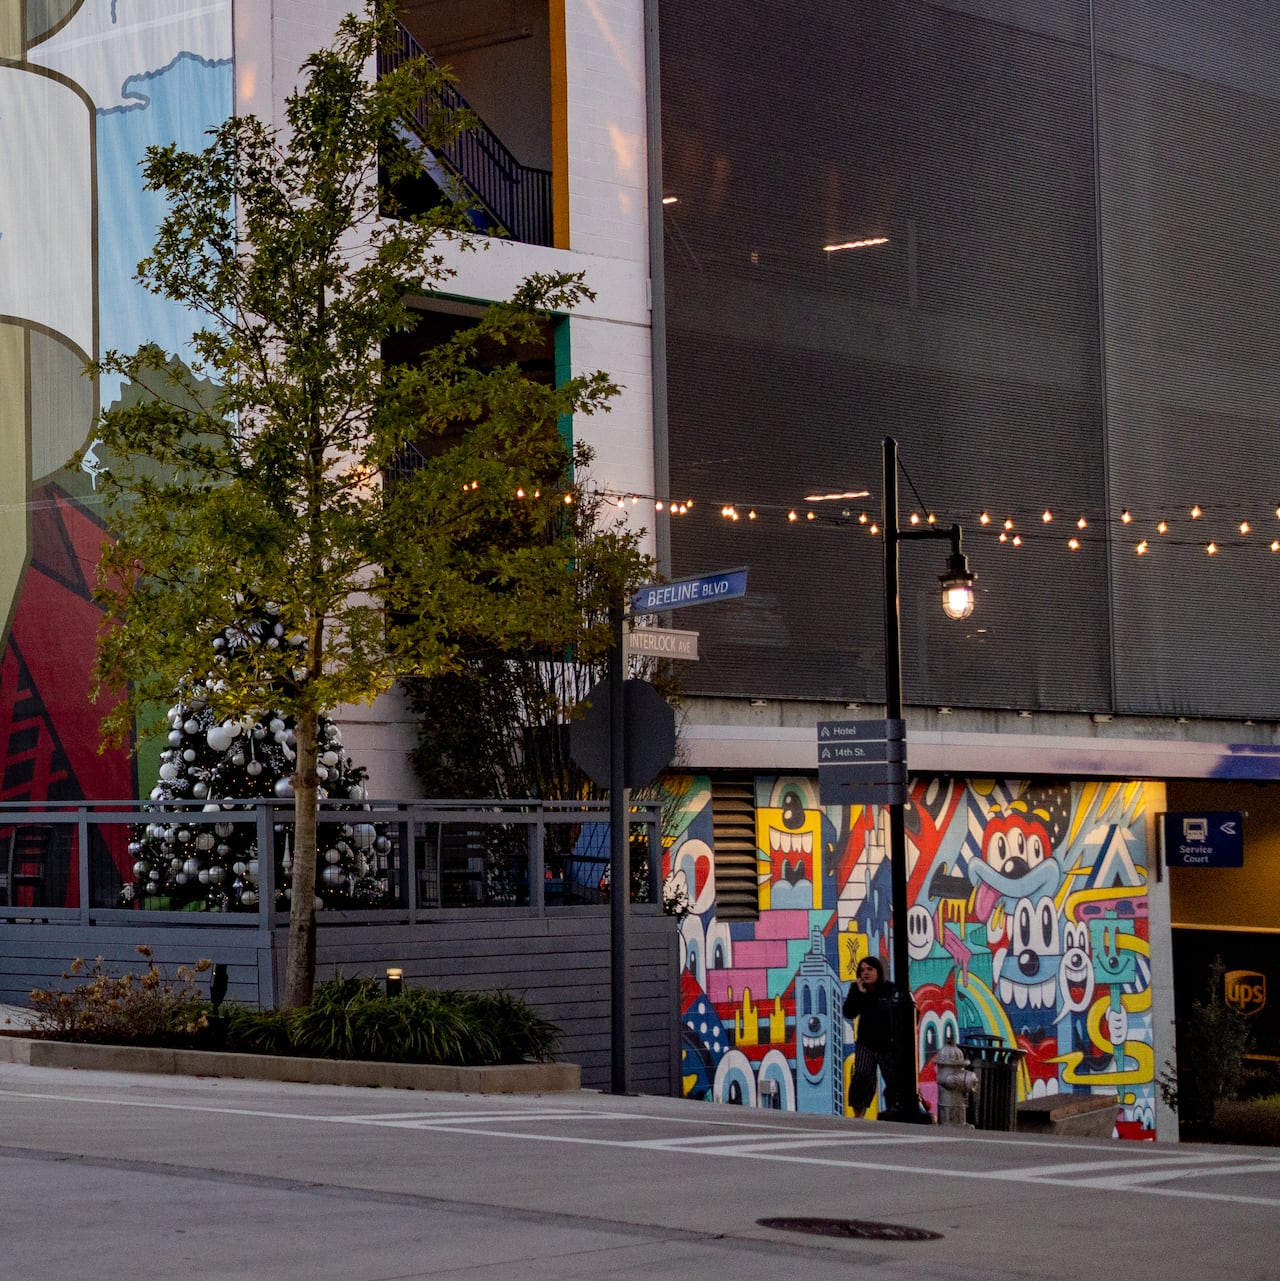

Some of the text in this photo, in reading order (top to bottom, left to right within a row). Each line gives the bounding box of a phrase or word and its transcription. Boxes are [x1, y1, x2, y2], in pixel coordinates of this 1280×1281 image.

[647, 580, 729, 607] BEELINE BLVD
[629, 632, 691, 654] INTERLOCK AVE
[833, 726, 857, 735] Hotel
[835, 747, 866, 757] 14th St.
[1179, 844, 1214, 854] Service
[1183, 854, 1209, 863] Court
[1228, 984, 1264, 1009] ups
